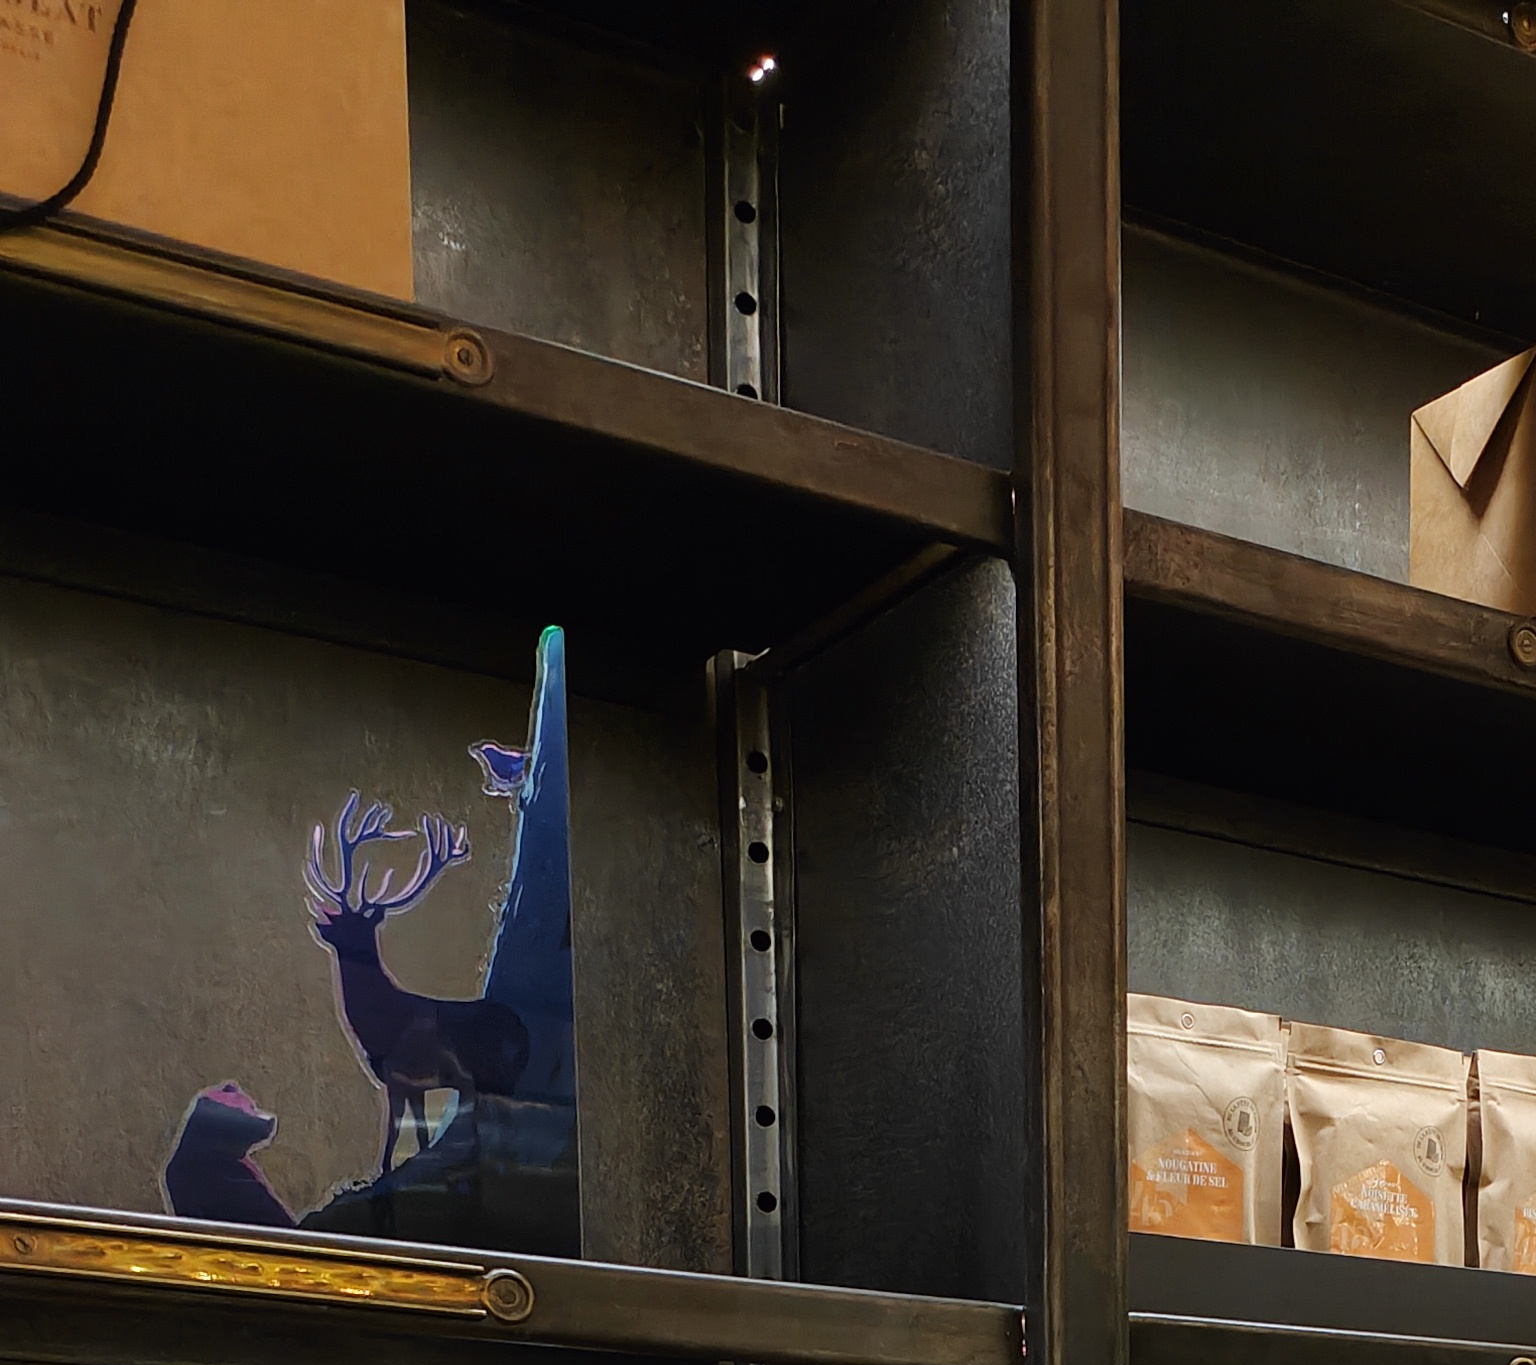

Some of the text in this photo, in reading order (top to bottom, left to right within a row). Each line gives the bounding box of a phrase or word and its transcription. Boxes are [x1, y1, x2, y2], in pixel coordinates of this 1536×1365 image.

[1158, 1157, 1217, 1174] NOUGATINE
[1156, 1171, 1229, 1188] FLEUR DE SEL
[1361, 1184, 1408, 1205] NOISETTE
